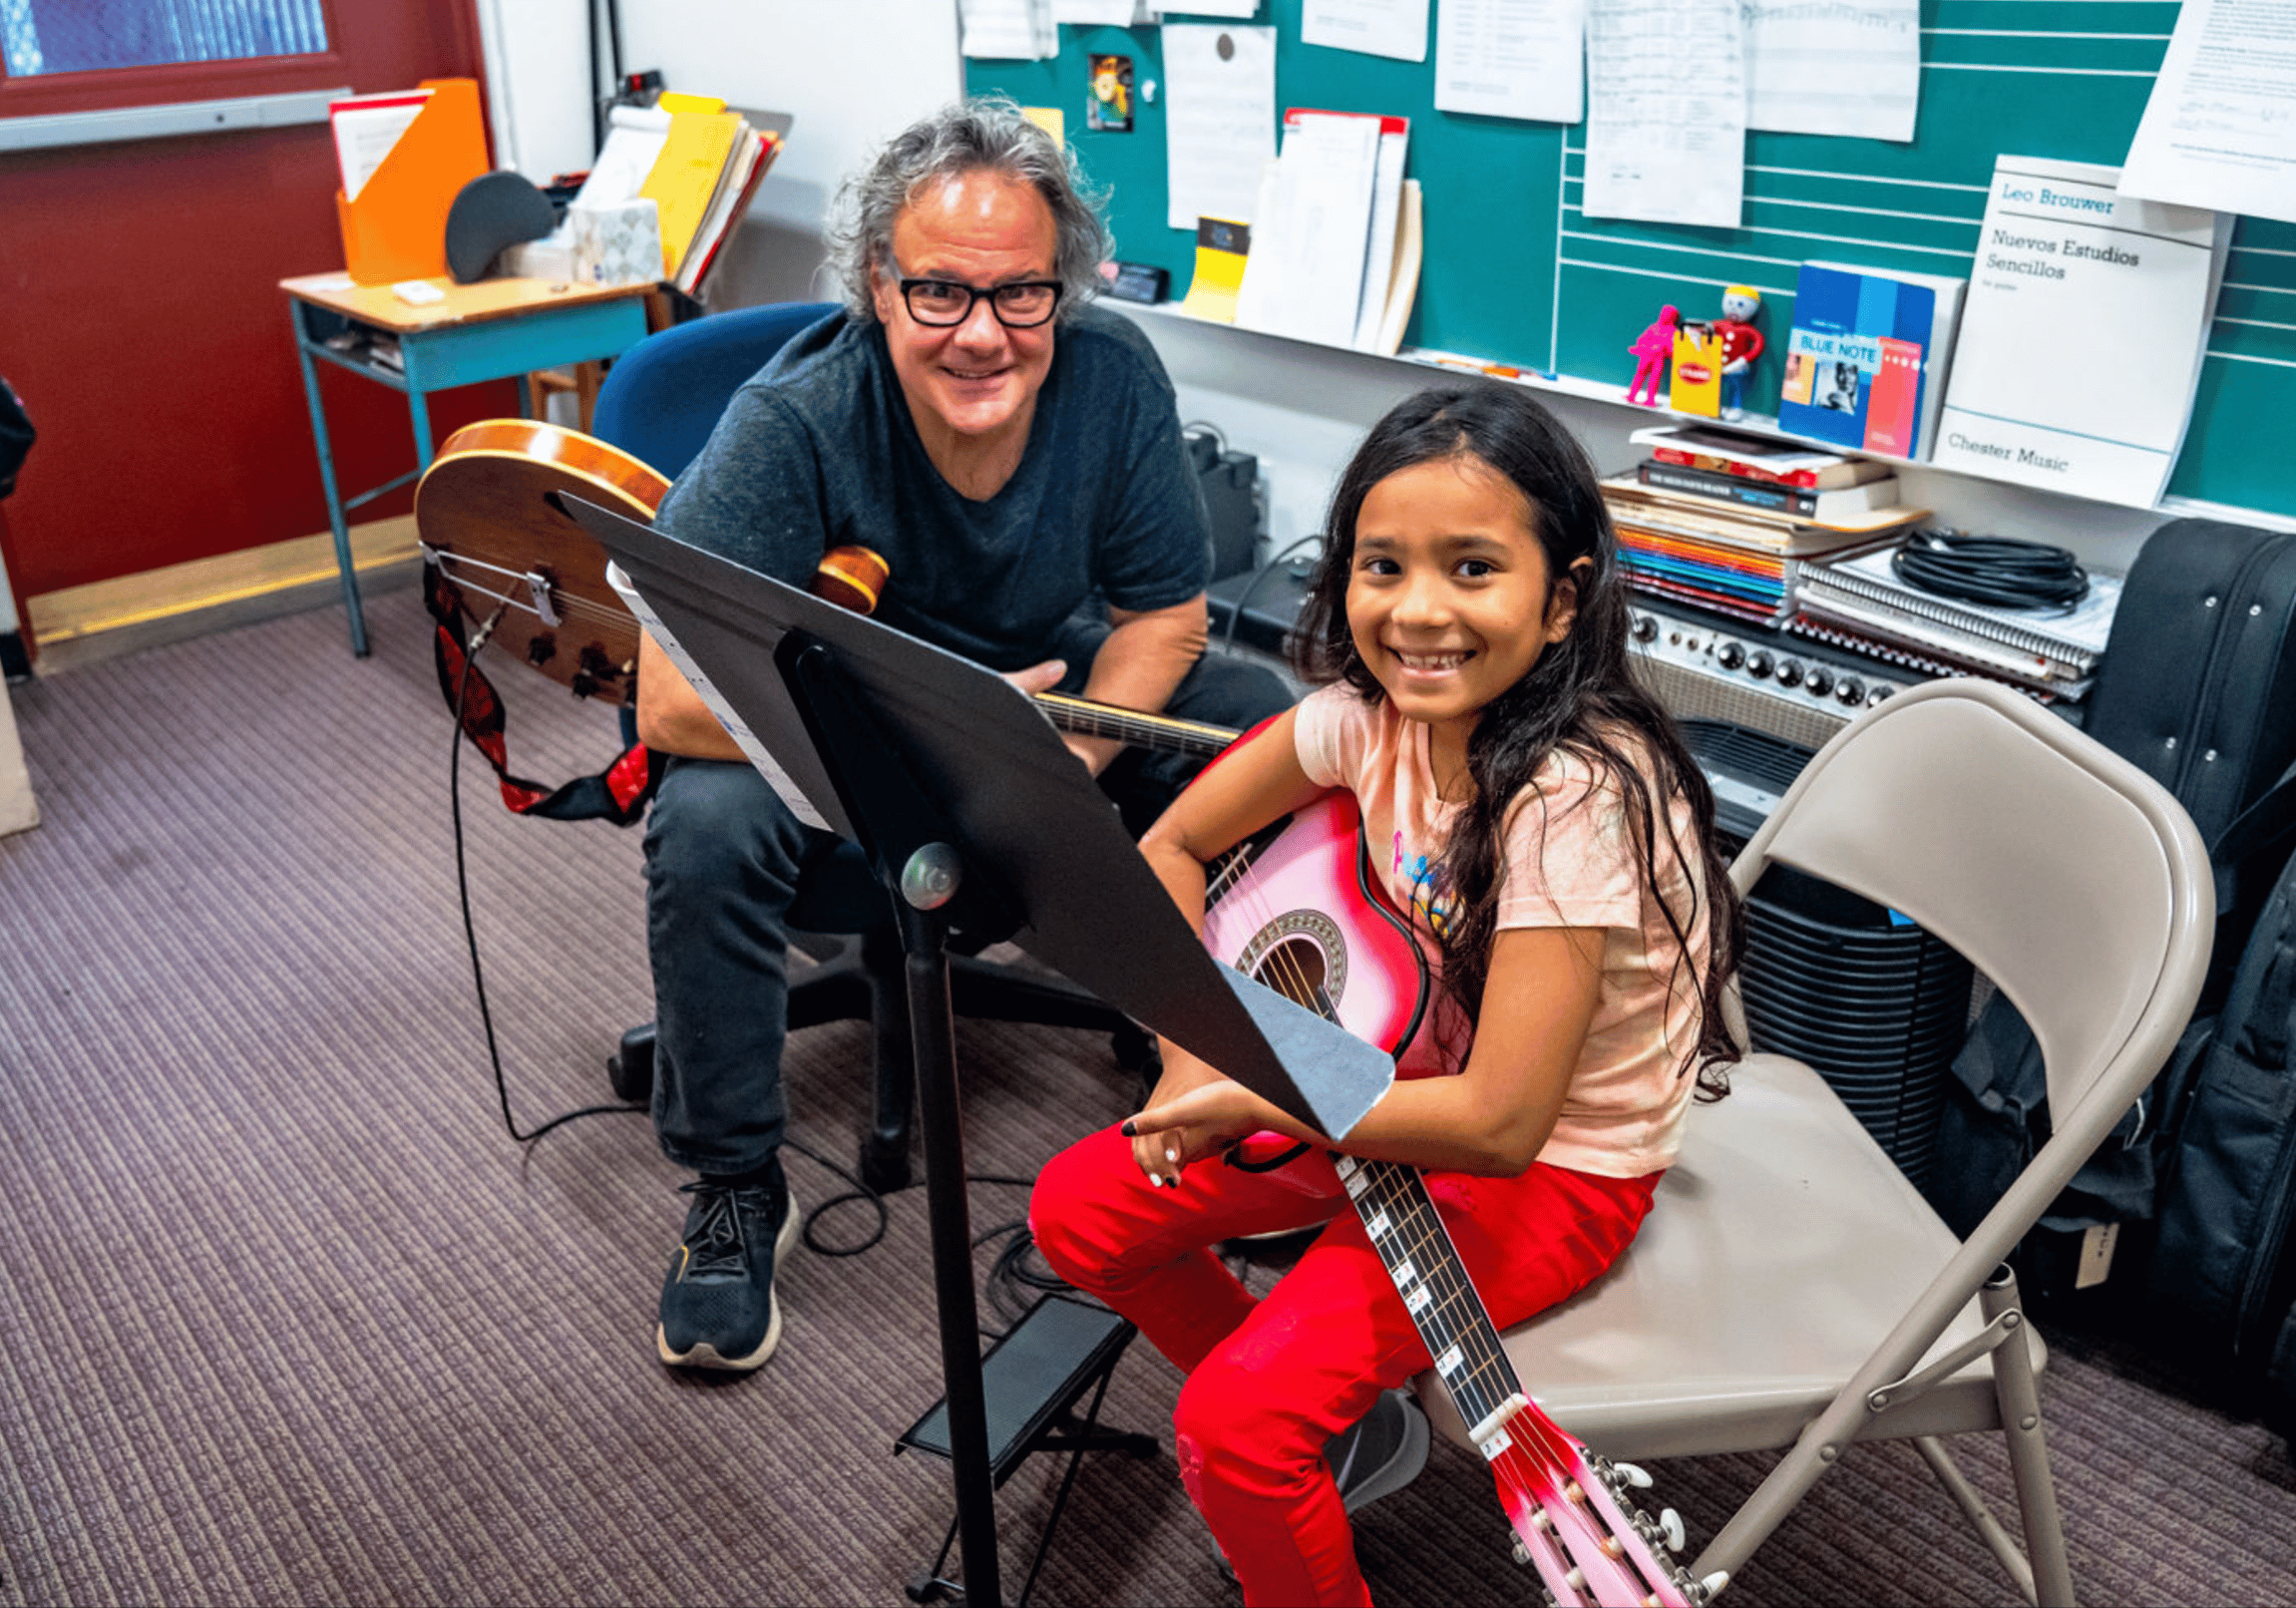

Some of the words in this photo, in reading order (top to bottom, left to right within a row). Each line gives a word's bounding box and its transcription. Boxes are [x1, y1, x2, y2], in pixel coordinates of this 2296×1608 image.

[2002, 184, 2034, 202] Leo
[2040, 188, 2114, 214] Brouwer
[1991, 229, 2058, 253] Nuevos
[2063, 239, 2140, 267] Estudios
[1986, 253, 2066, 280] Sencillos
[1800, 335, 1834, 355] BLUE
[1838, 343, 1877, 364] NOTE
[1948, 432, 2012, 461] Chester
[2017, 448, 2070, 473] Music
